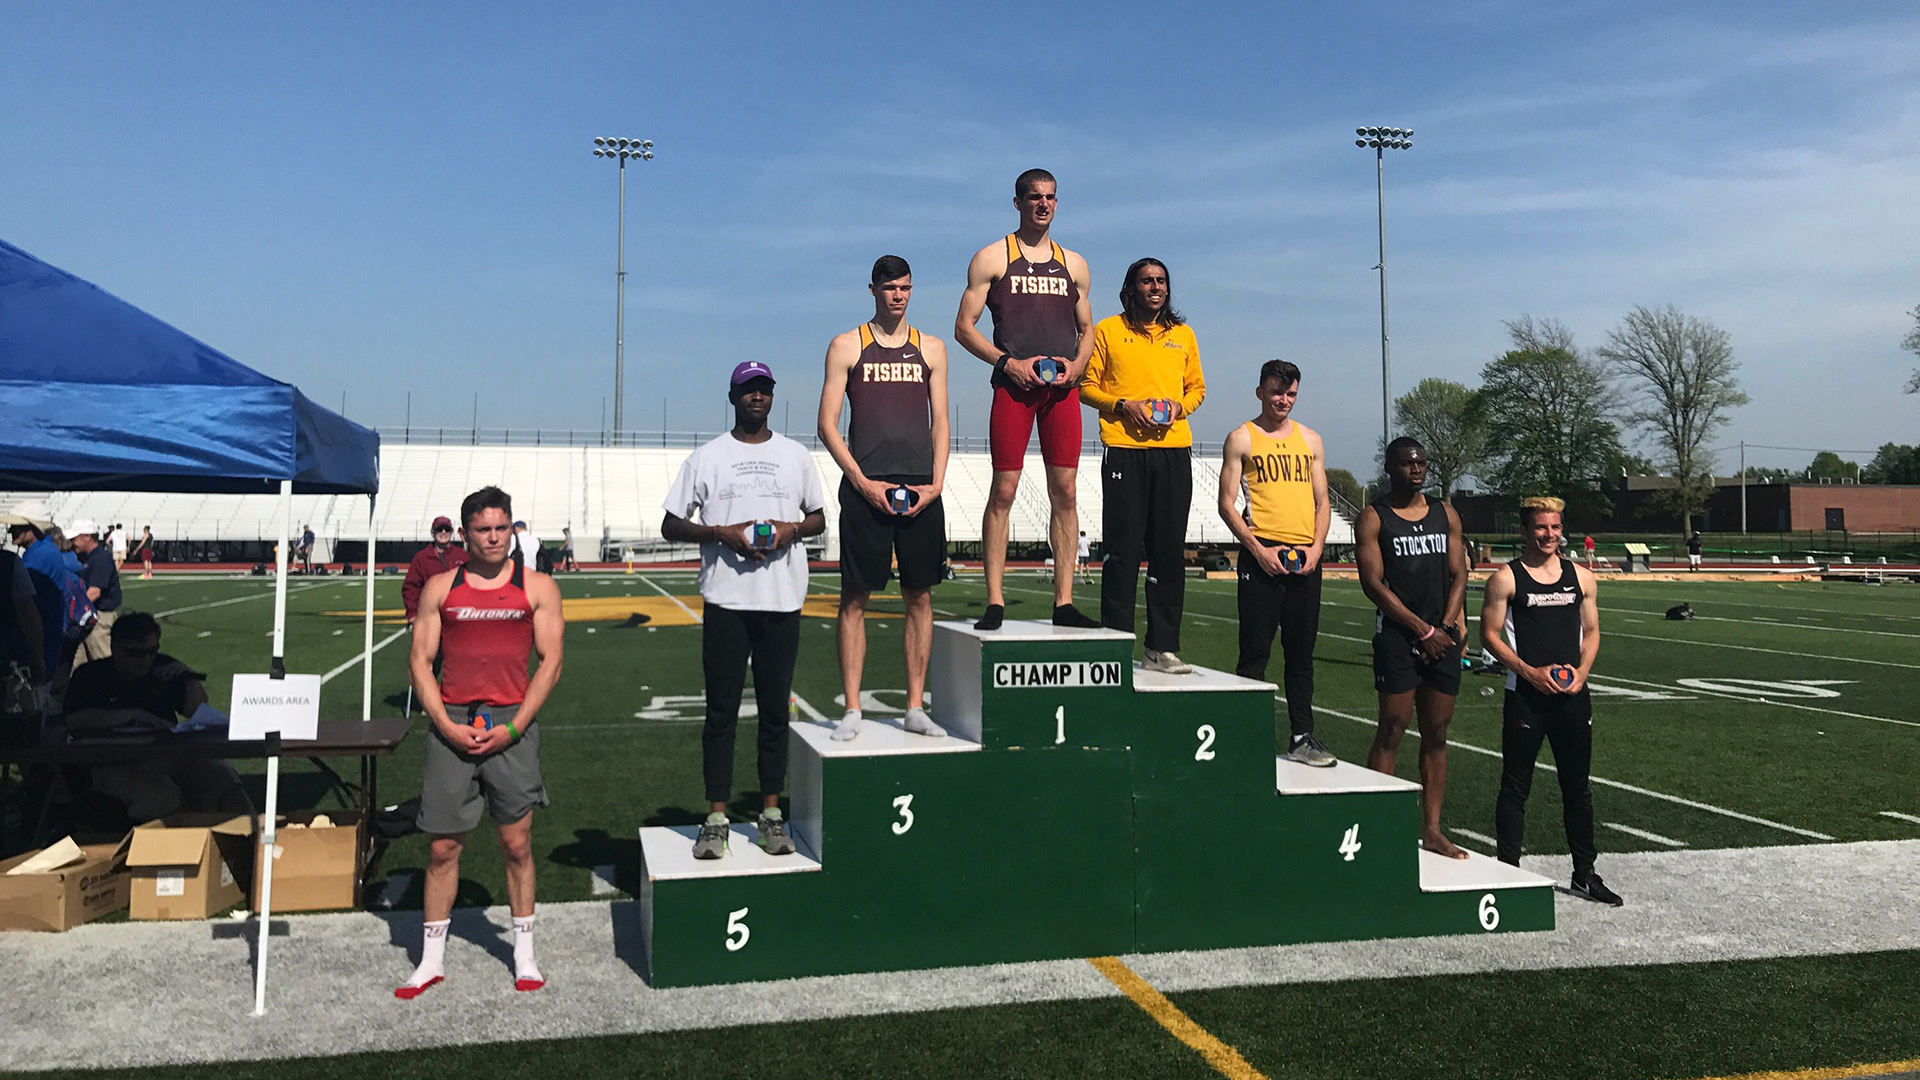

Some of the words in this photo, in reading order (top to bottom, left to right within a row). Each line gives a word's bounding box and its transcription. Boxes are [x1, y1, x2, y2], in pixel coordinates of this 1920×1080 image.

[1010, 275, 1068, 297] FISHER
[863, 362, 923, 383] FISHER
[1252, 453, 1313, 483] ROWAN
[1393, 533, 1447, 557] STOCKTON
[446, 605, 525, 621] ONEONTA
[995, 663, 1120, 686] CHAMPION
[242, 696, 284, 706] AWARDS
[285, 696, 310, 706] AREA
[1055, 705, 1066, 745] 1
[1194, 724, 1216, 761] 2
[891, 793, 915, 835] 3
[1338, 823, 1362, 862] 4
[1478, 893, 1500, 930] 6
[725, 906, 750, 951] 5
